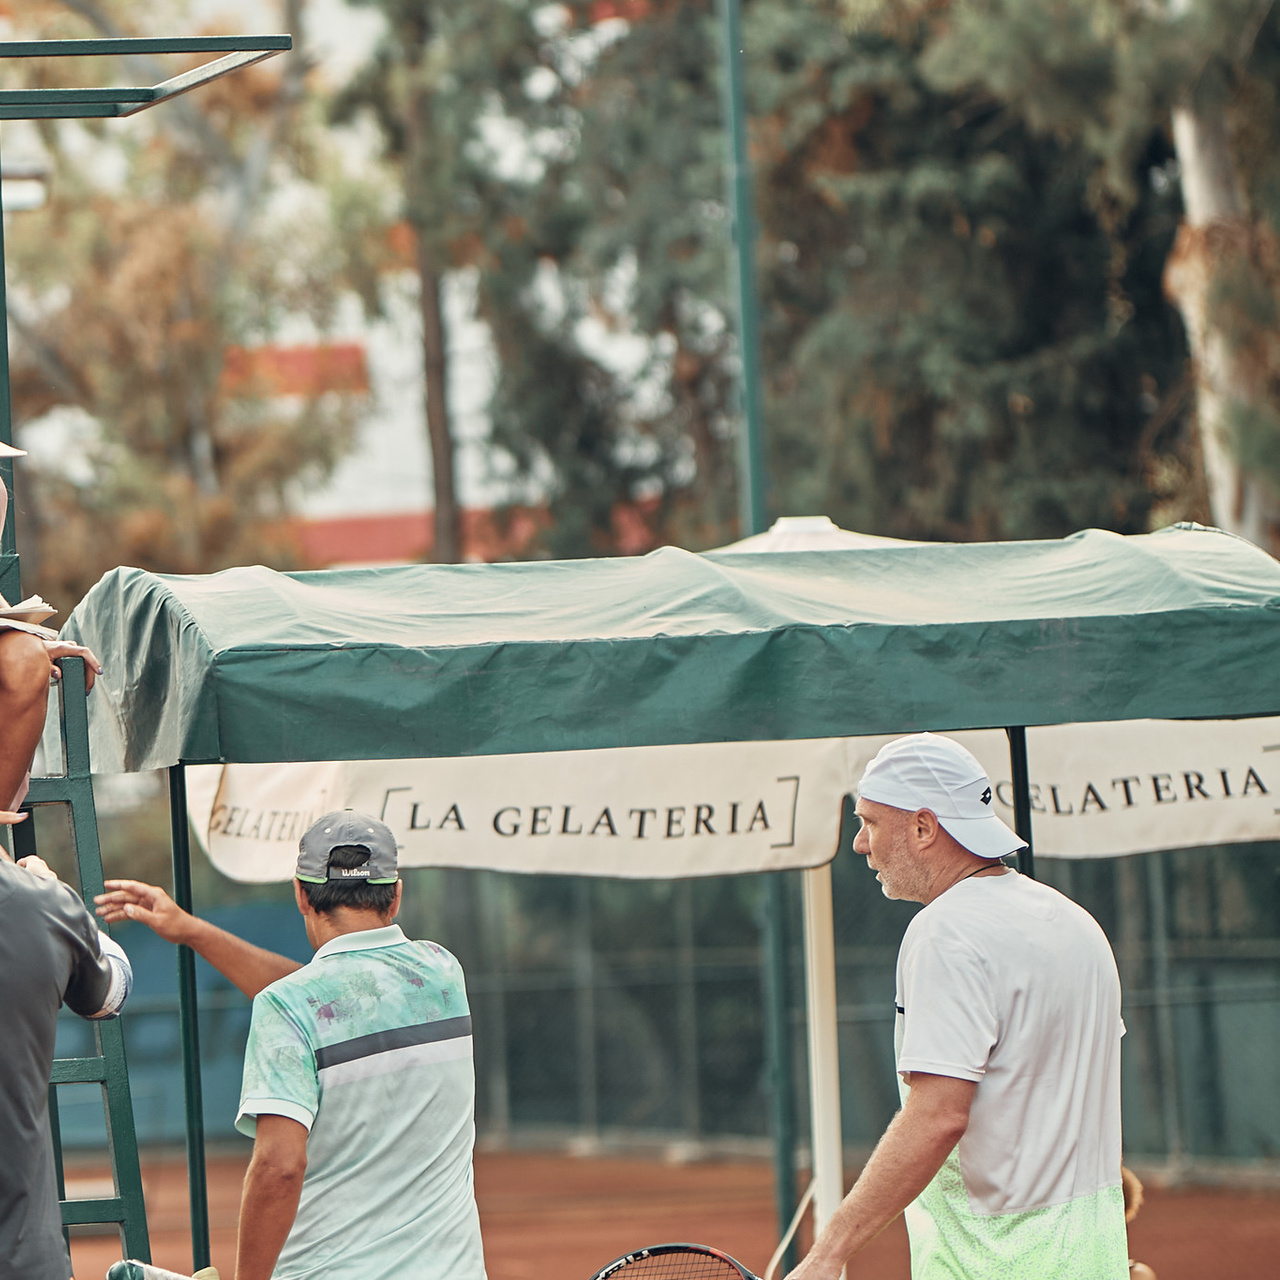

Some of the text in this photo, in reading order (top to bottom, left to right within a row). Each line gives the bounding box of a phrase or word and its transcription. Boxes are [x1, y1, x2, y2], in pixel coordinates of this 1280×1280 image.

[407, 799, 773, 840] LA GELATERIA
[341, 868, 371, 877] Wilson
